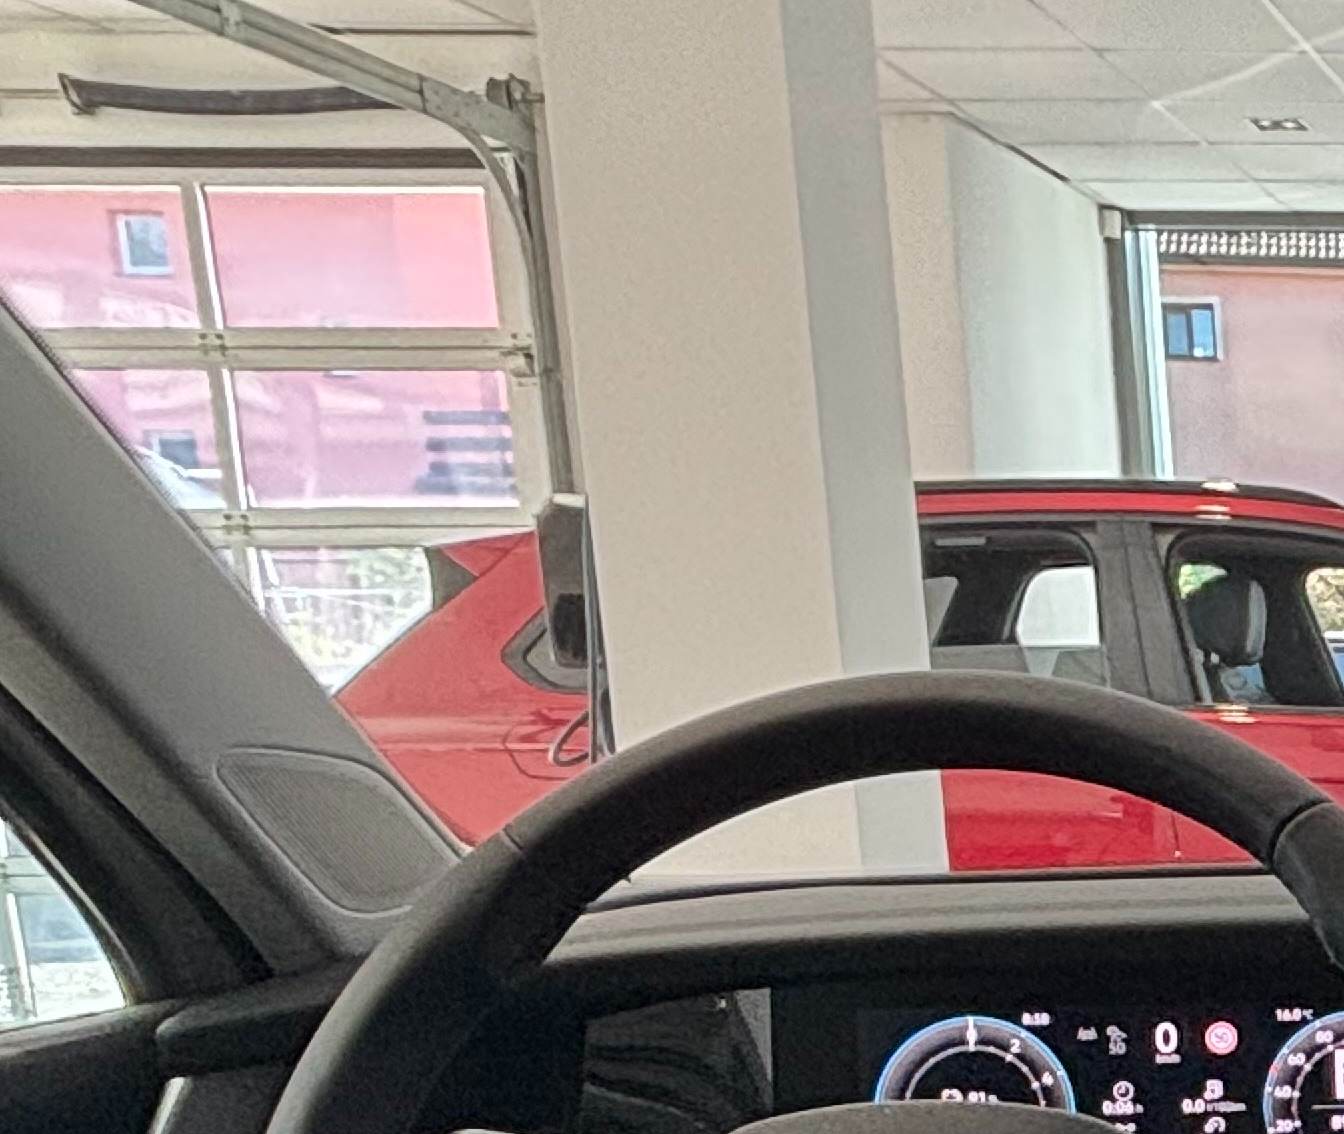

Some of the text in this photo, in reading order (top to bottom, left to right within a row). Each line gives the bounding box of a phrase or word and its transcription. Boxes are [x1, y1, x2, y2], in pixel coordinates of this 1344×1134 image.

[1155, 1021, 1178, 1054] 0
[1010, 1038, 1021, 1053] 2
[1276, 1119, 1294, 1133] 20
